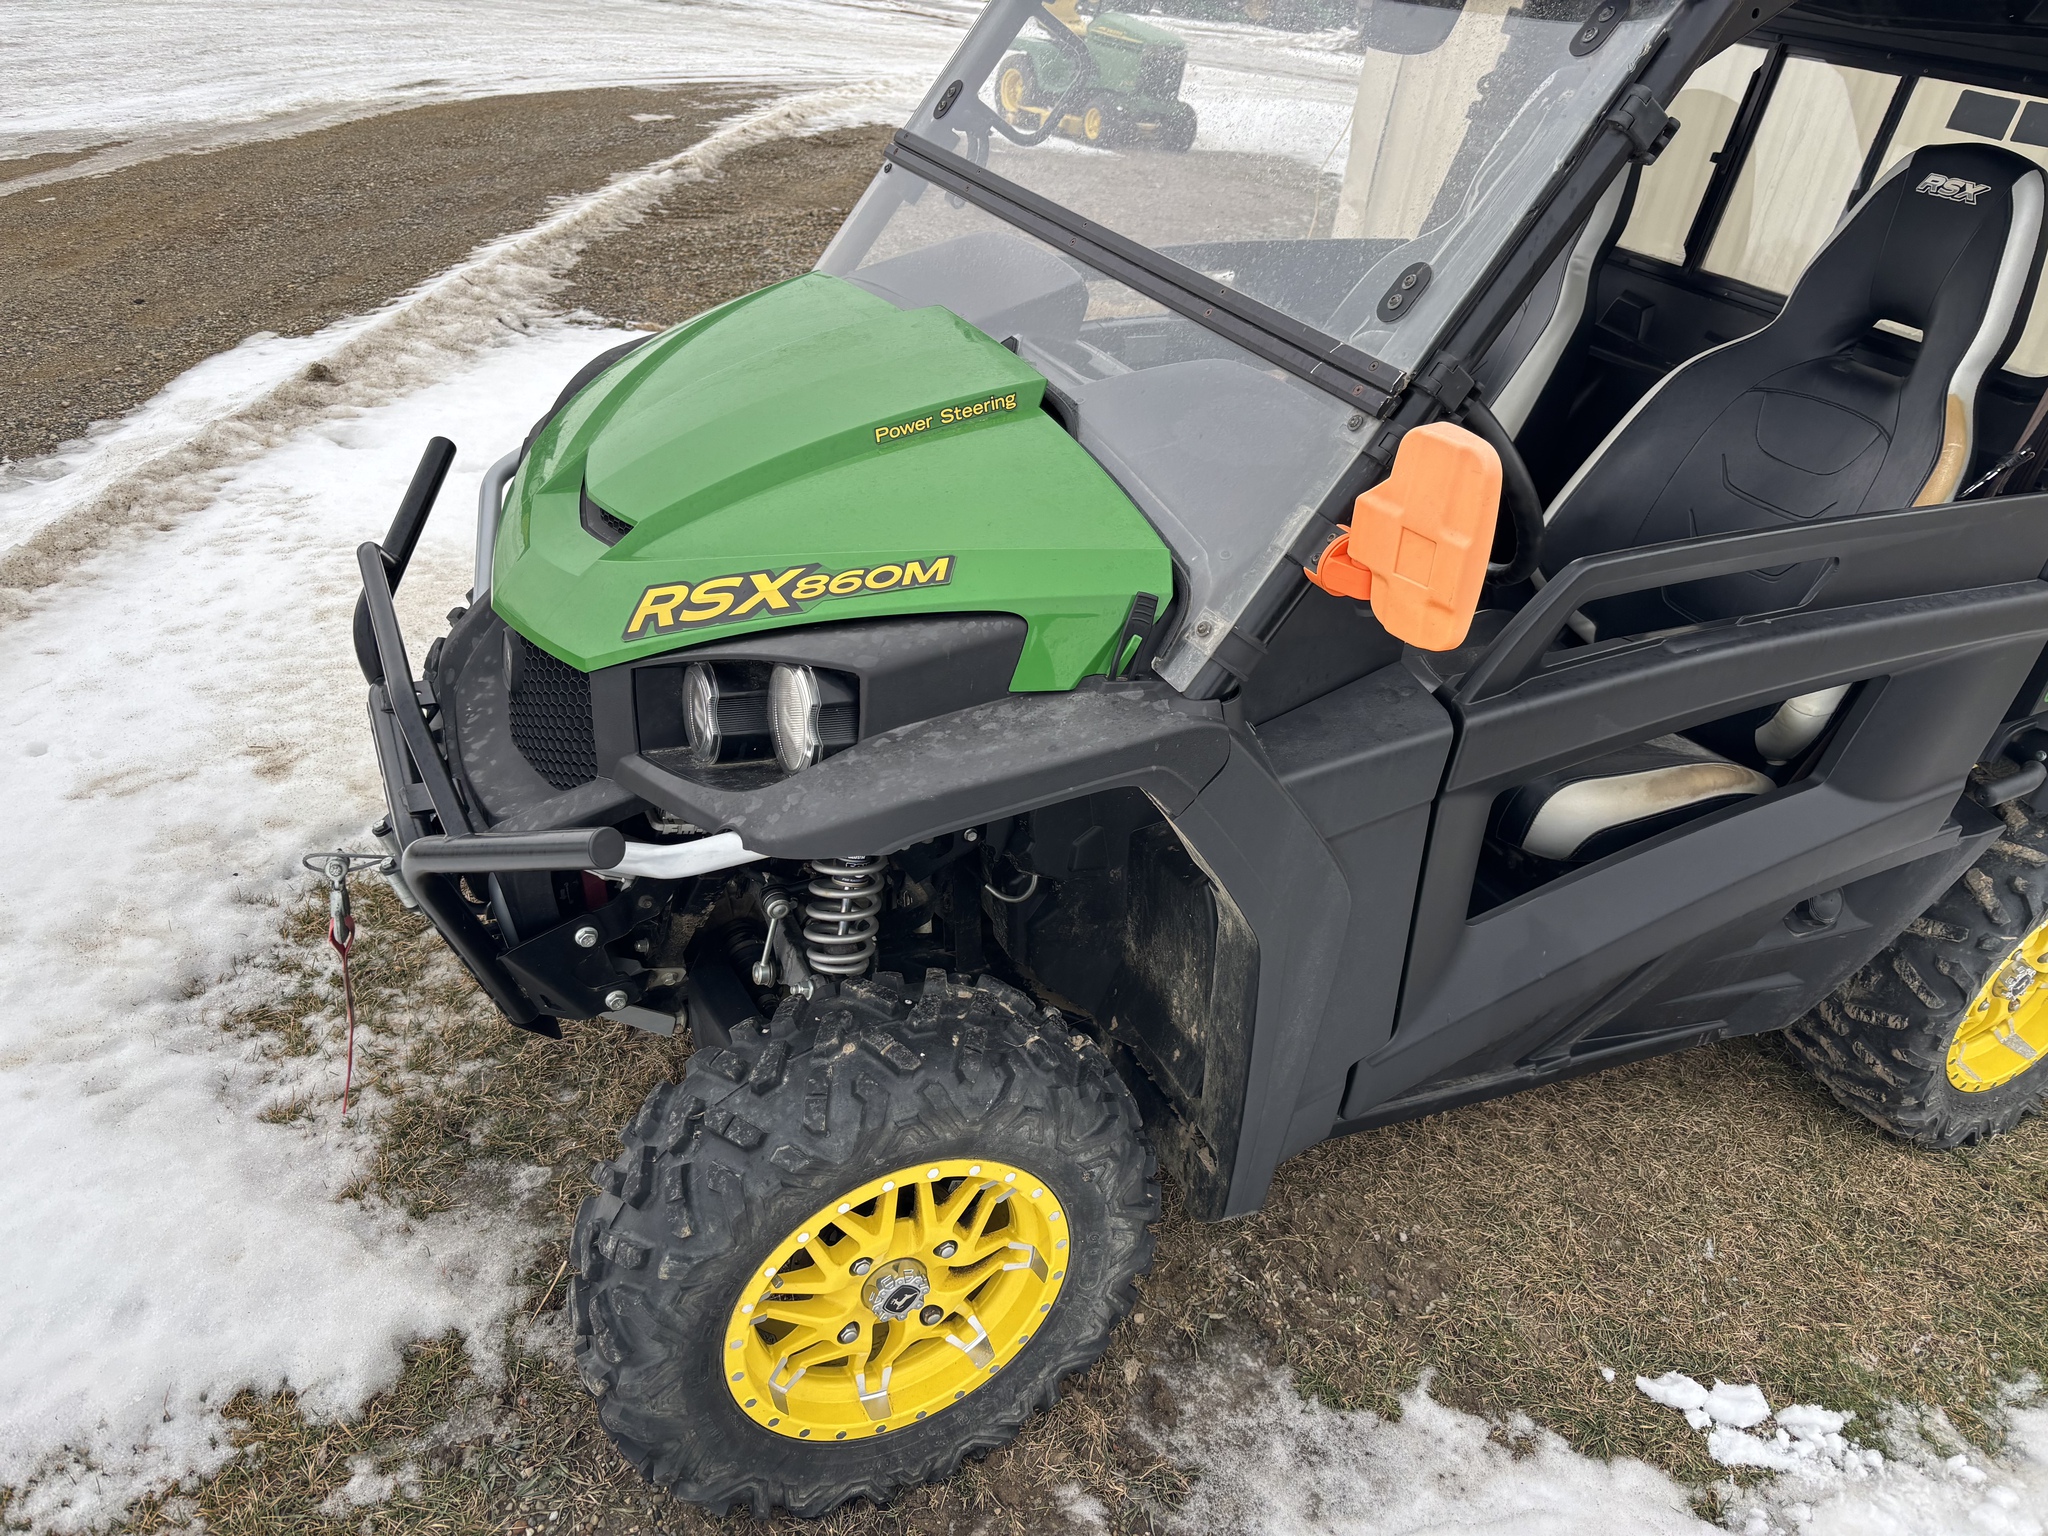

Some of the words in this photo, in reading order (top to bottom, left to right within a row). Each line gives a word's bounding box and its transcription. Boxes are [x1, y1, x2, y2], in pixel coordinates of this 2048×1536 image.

[1916, 173, 1991, 204] RSX
[875, 415, 933, 443] Power
[940, 393, 1017, 423] Steering
